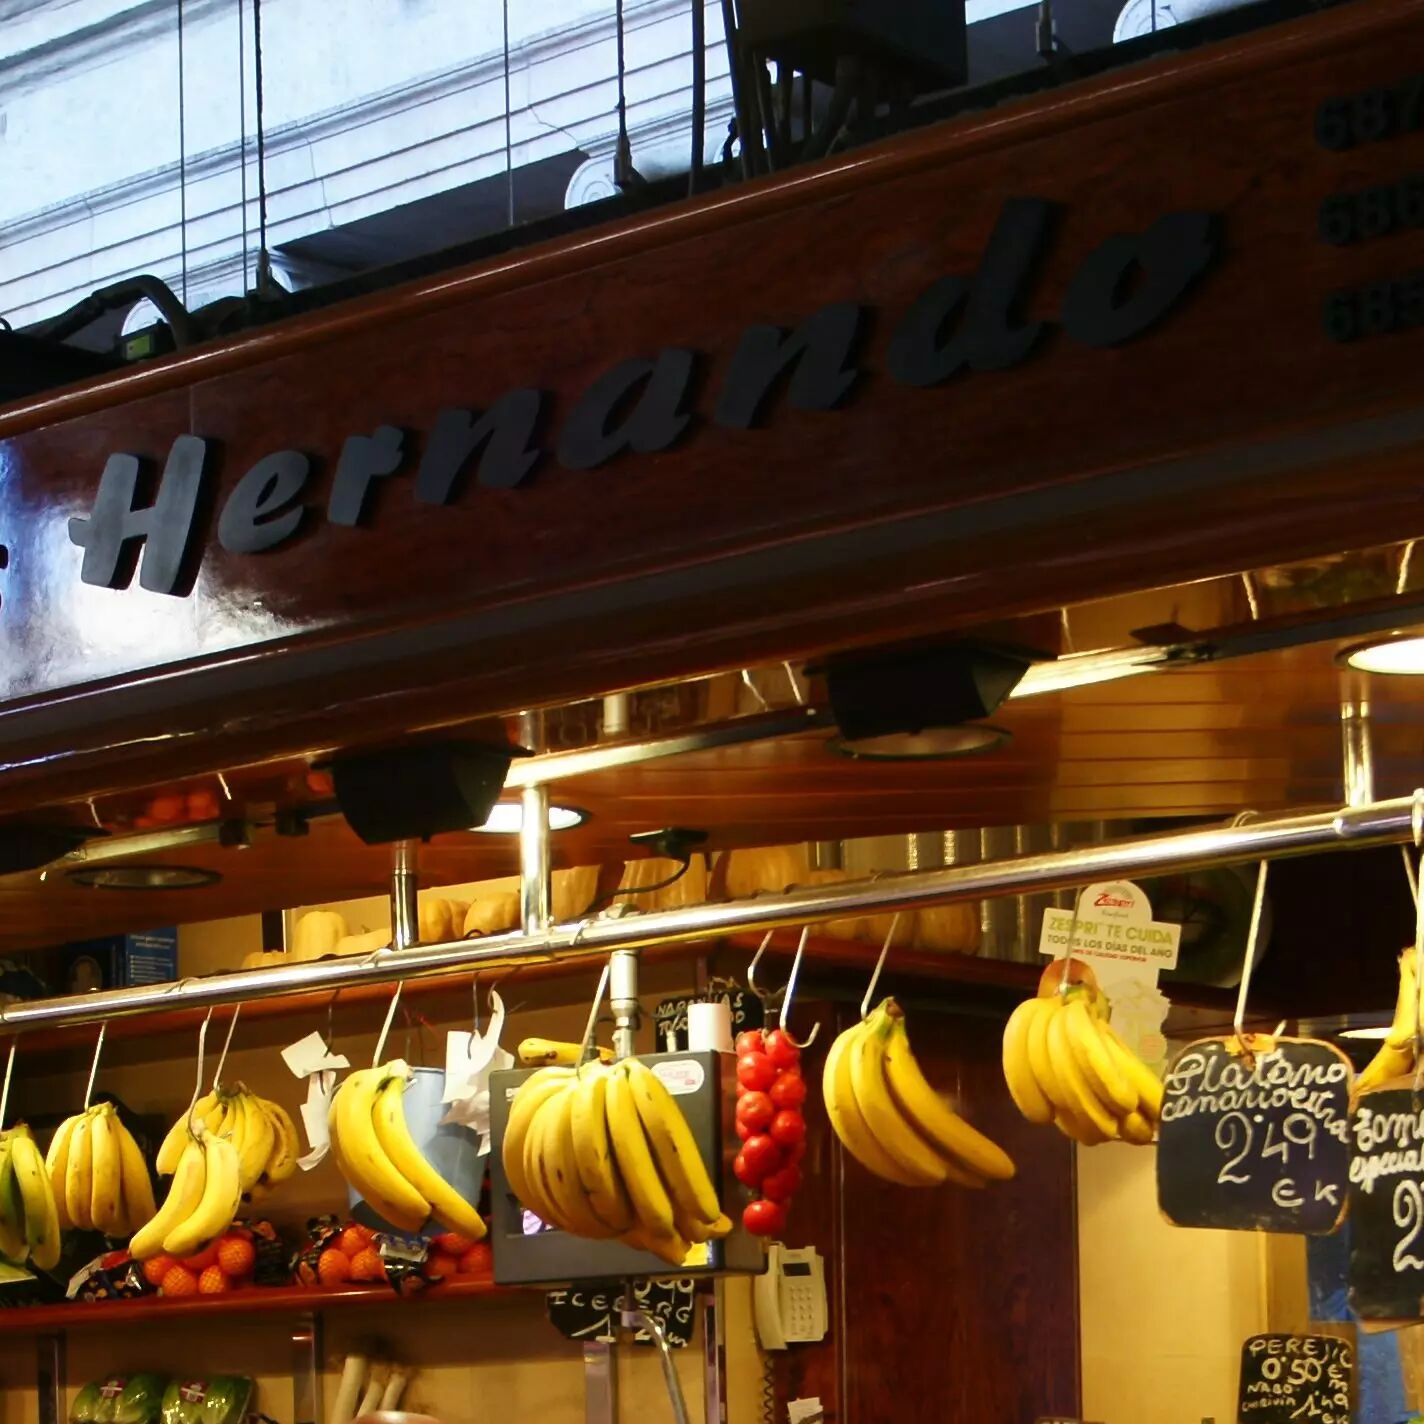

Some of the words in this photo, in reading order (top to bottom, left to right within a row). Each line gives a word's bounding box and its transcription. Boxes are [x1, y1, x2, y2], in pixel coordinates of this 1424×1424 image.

[68, 198, 1222, 598] Hernando
[1107, 925, 1121, 938] TE
[1125, 927, 1174, 945] CUIDA
[1084, 940, 1102, 949] LOS
[1130, 944, 1147, 955] DEL
